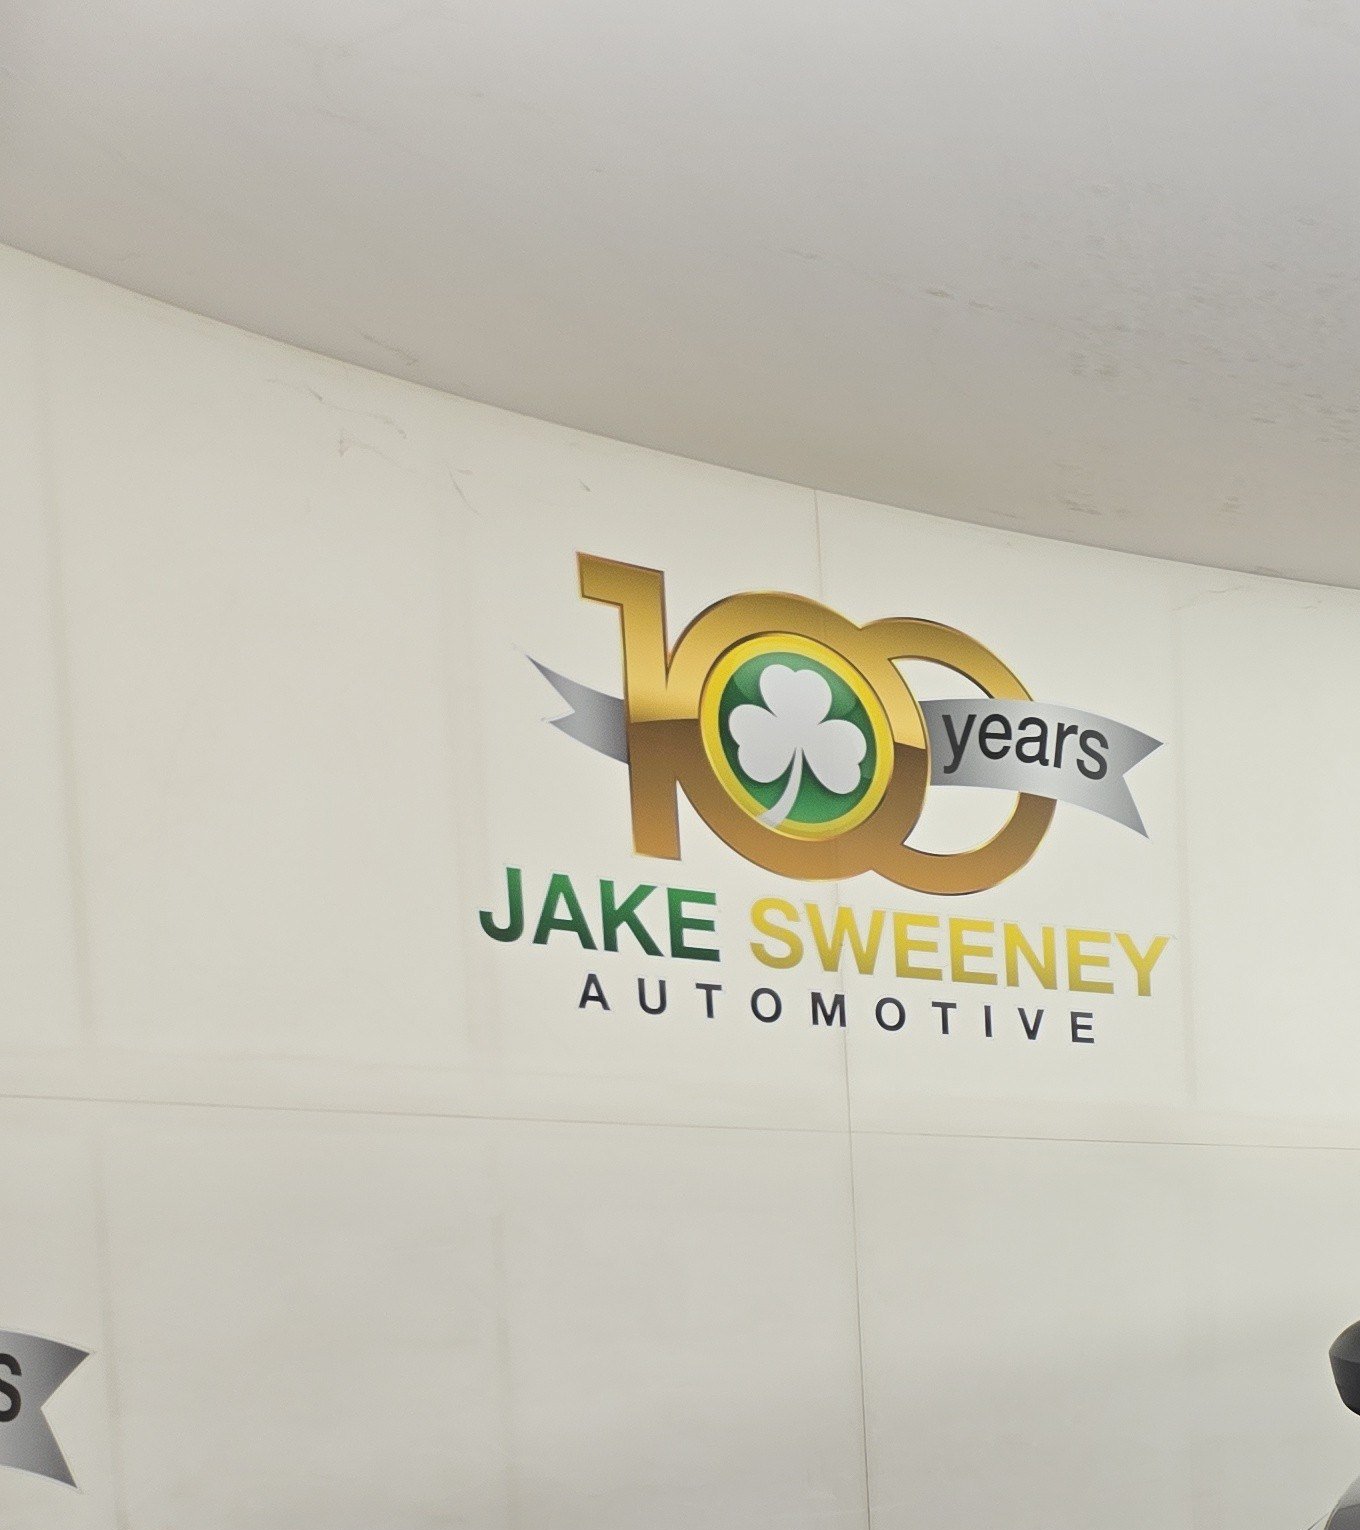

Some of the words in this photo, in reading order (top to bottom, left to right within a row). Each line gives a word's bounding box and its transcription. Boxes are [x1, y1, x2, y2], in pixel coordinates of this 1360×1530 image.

[575, 551, 1057, 897] 100
[942, 711, 1109, 780] years
[479, 866, 722, 963] JAKE
[749, 897, 1170, 998] SWEENEY
[578, 972, 1096, 1044] AUTOMOTIVE
